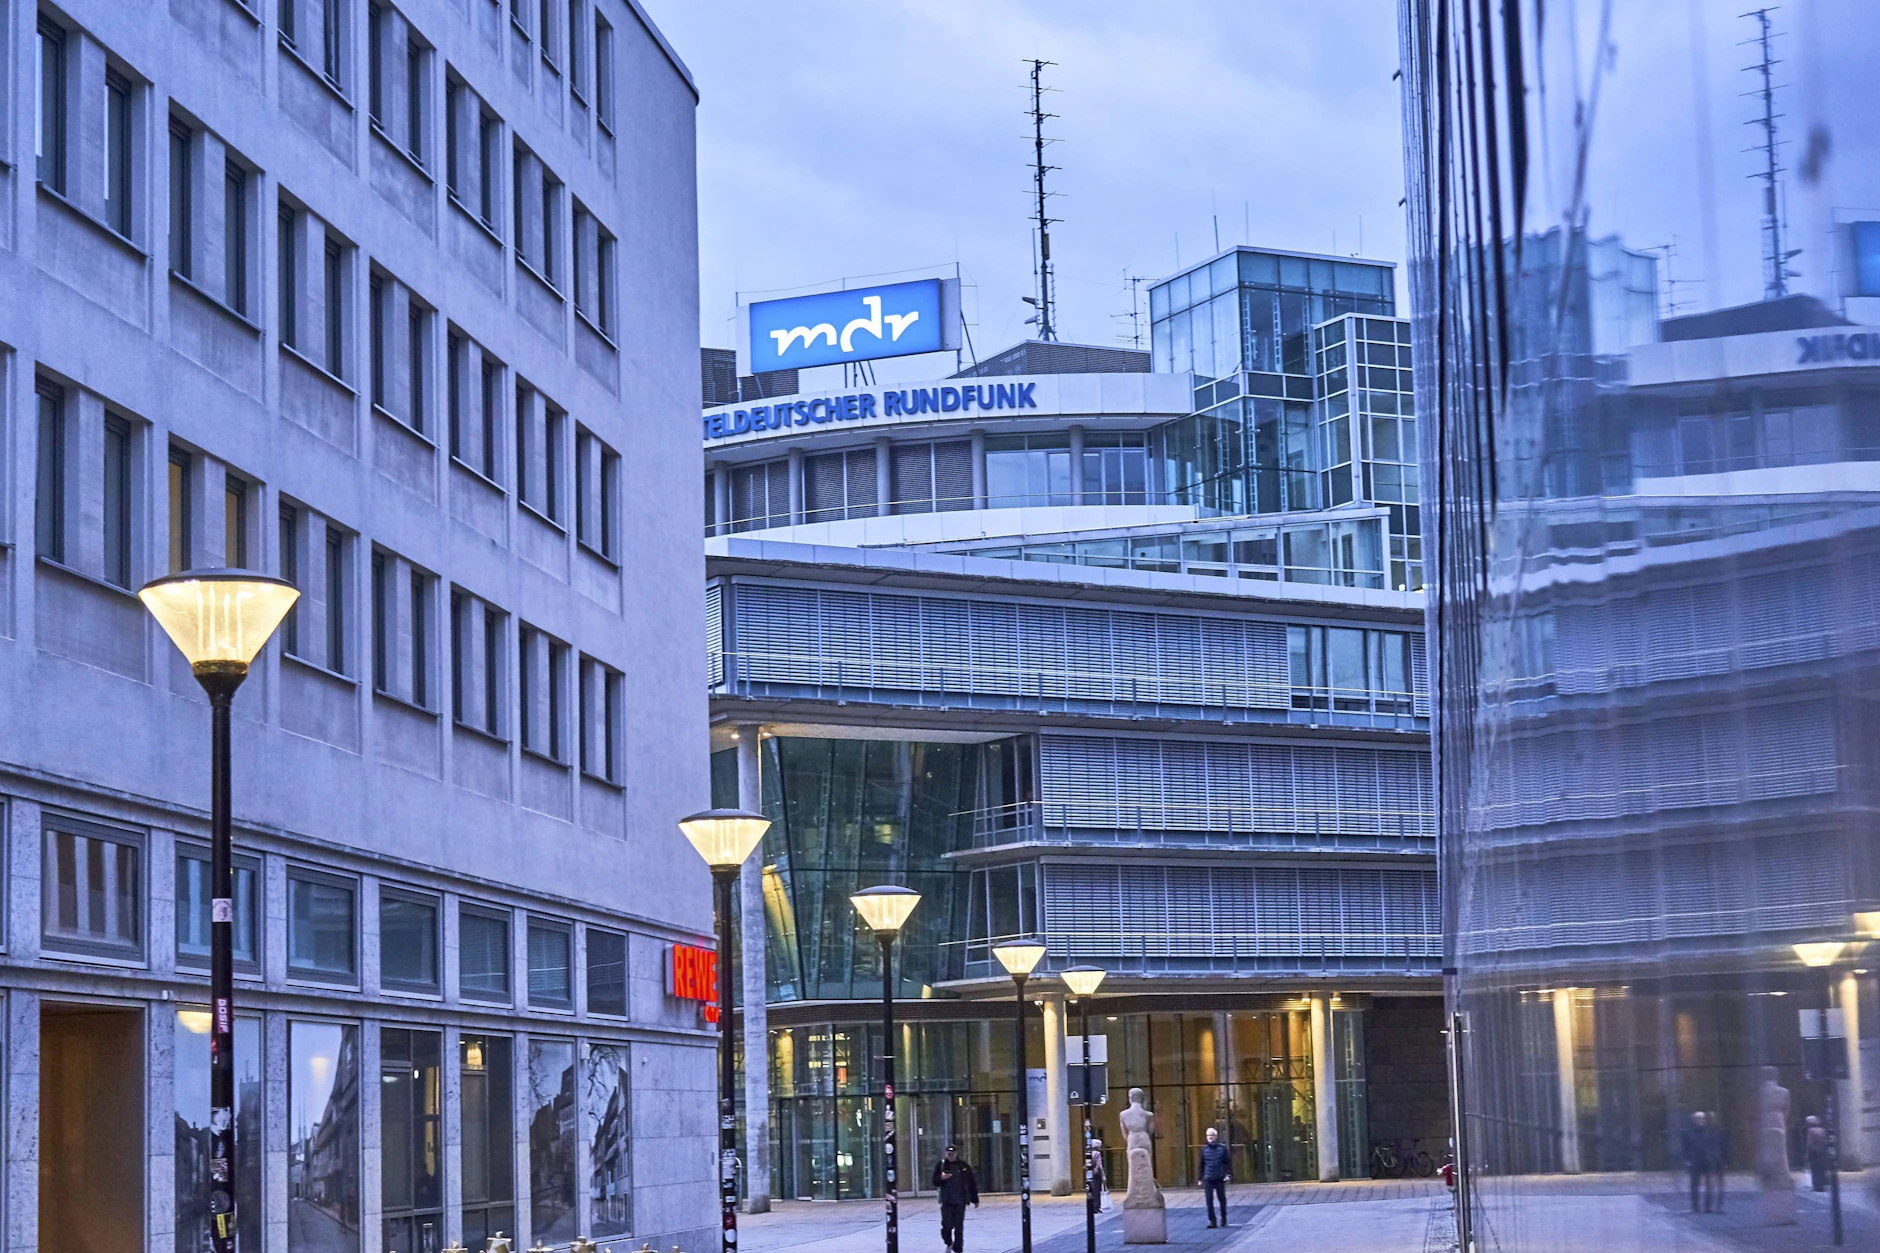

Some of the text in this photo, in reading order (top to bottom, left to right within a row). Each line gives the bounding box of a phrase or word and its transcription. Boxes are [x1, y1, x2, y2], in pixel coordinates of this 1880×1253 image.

[770, 296, 919, 356] mdr
[884, 383, 1037, 416] RUNDFUNK
[673, 944, 718, 1002] REWE
